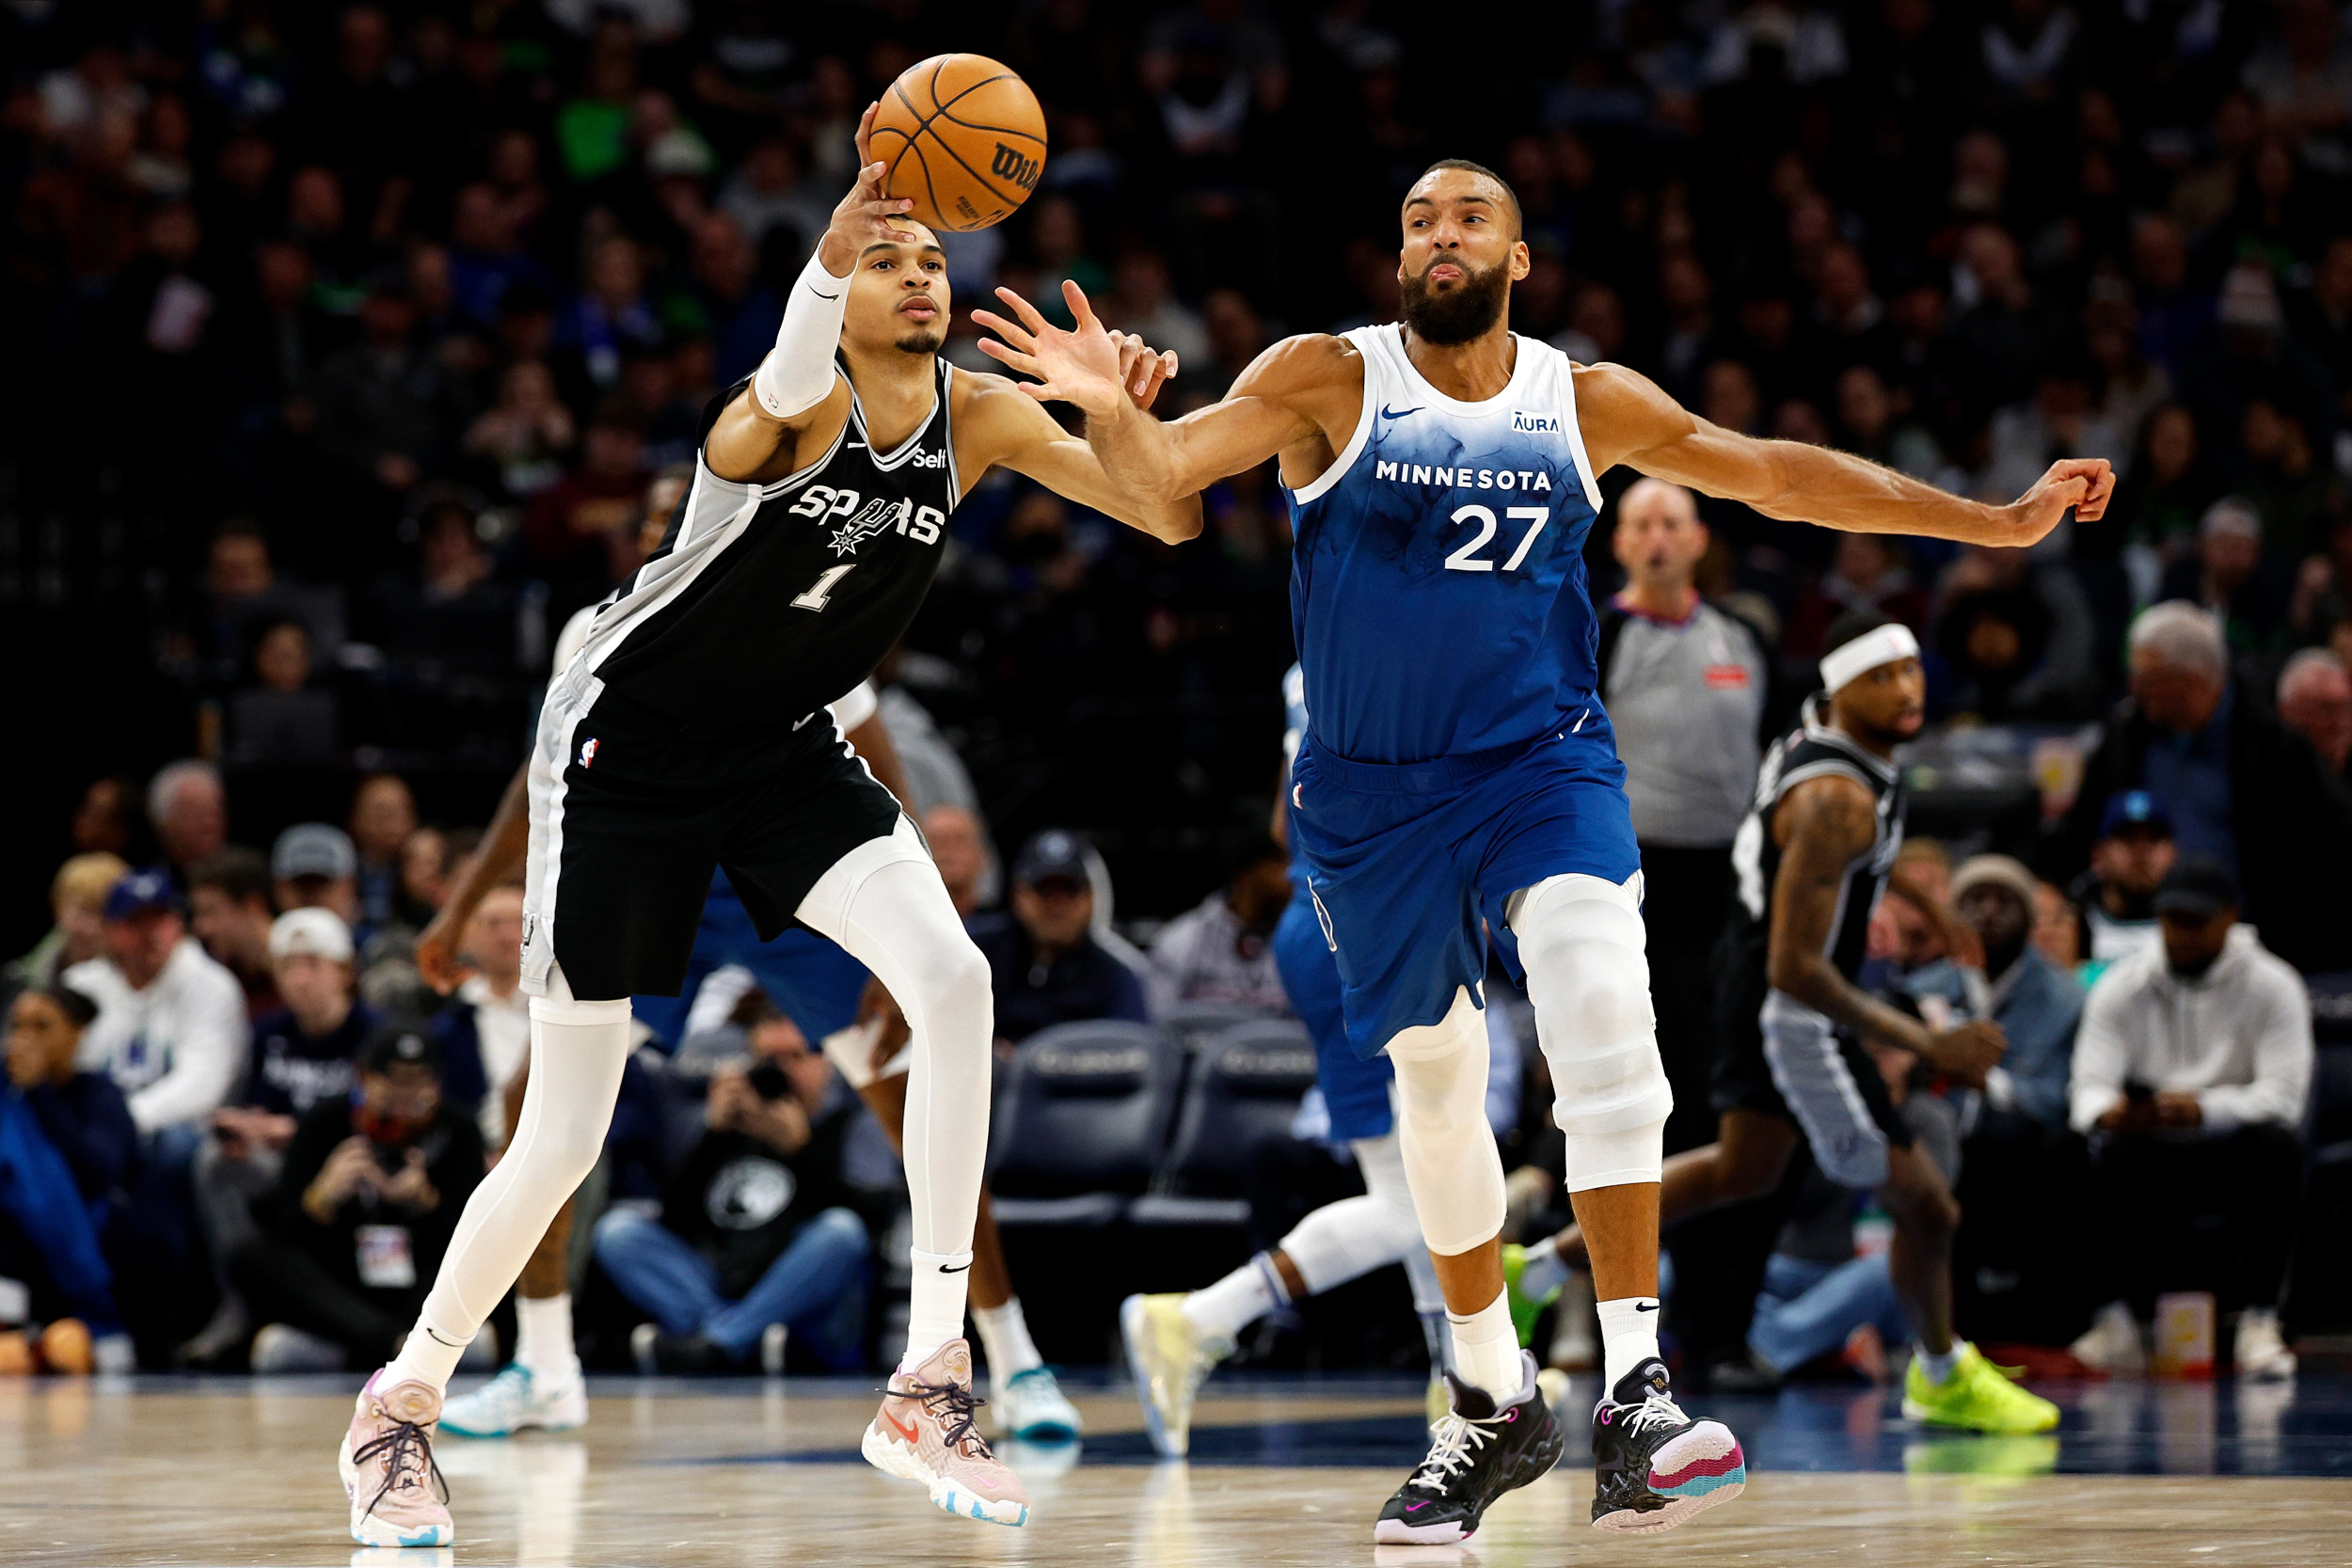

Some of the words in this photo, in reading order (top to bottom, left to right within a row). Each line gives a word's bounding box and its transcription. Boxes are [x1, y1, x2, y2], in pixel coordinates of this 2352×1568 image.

[1375, 460, 1552, 492] MINNESOTA
[788, 484, 946, 558] SPURS
[1444, 504, 1549, 572] 27
[789, 563, 857, 612] 1
